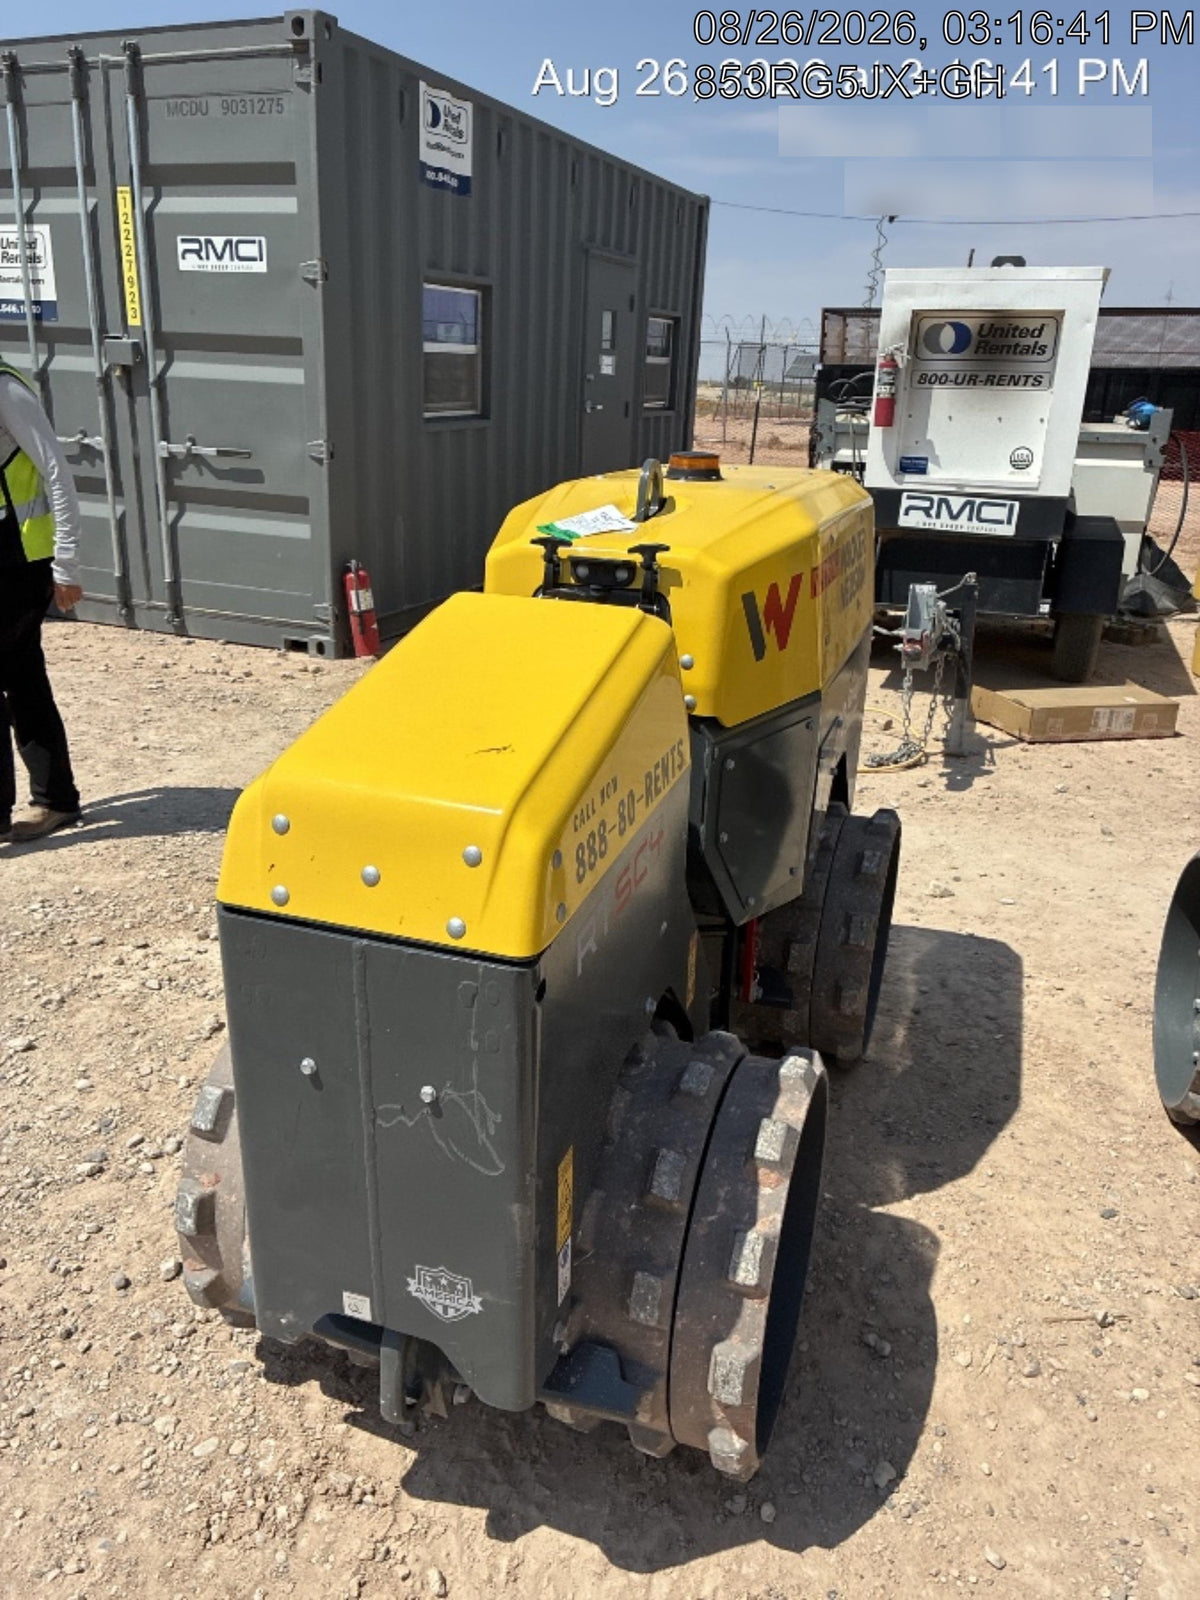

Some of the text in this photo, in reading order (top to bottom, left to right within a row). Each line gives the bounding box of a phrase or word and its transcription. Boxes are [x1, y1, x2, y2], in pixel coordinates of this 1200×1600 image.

[166, 97, 285, 118] MCDU 9031275
[1, 237, 38, 250] Unied
[180, 238, 264, 262] RMCI
[1, 251, 42, 264] Renals
[976, 322, 1043, 340] United
[974, 340, 1048, 357] Rentals
[917, 372, 1044, 388] 800-UR-RENTS
[903, 494, 1015, 525] RMCI
[573, 800, 597, 833] CALL
[575, 737, 684, 884] 888-80-RENTS
[413, 1286, 475, 1309] AMERICA
